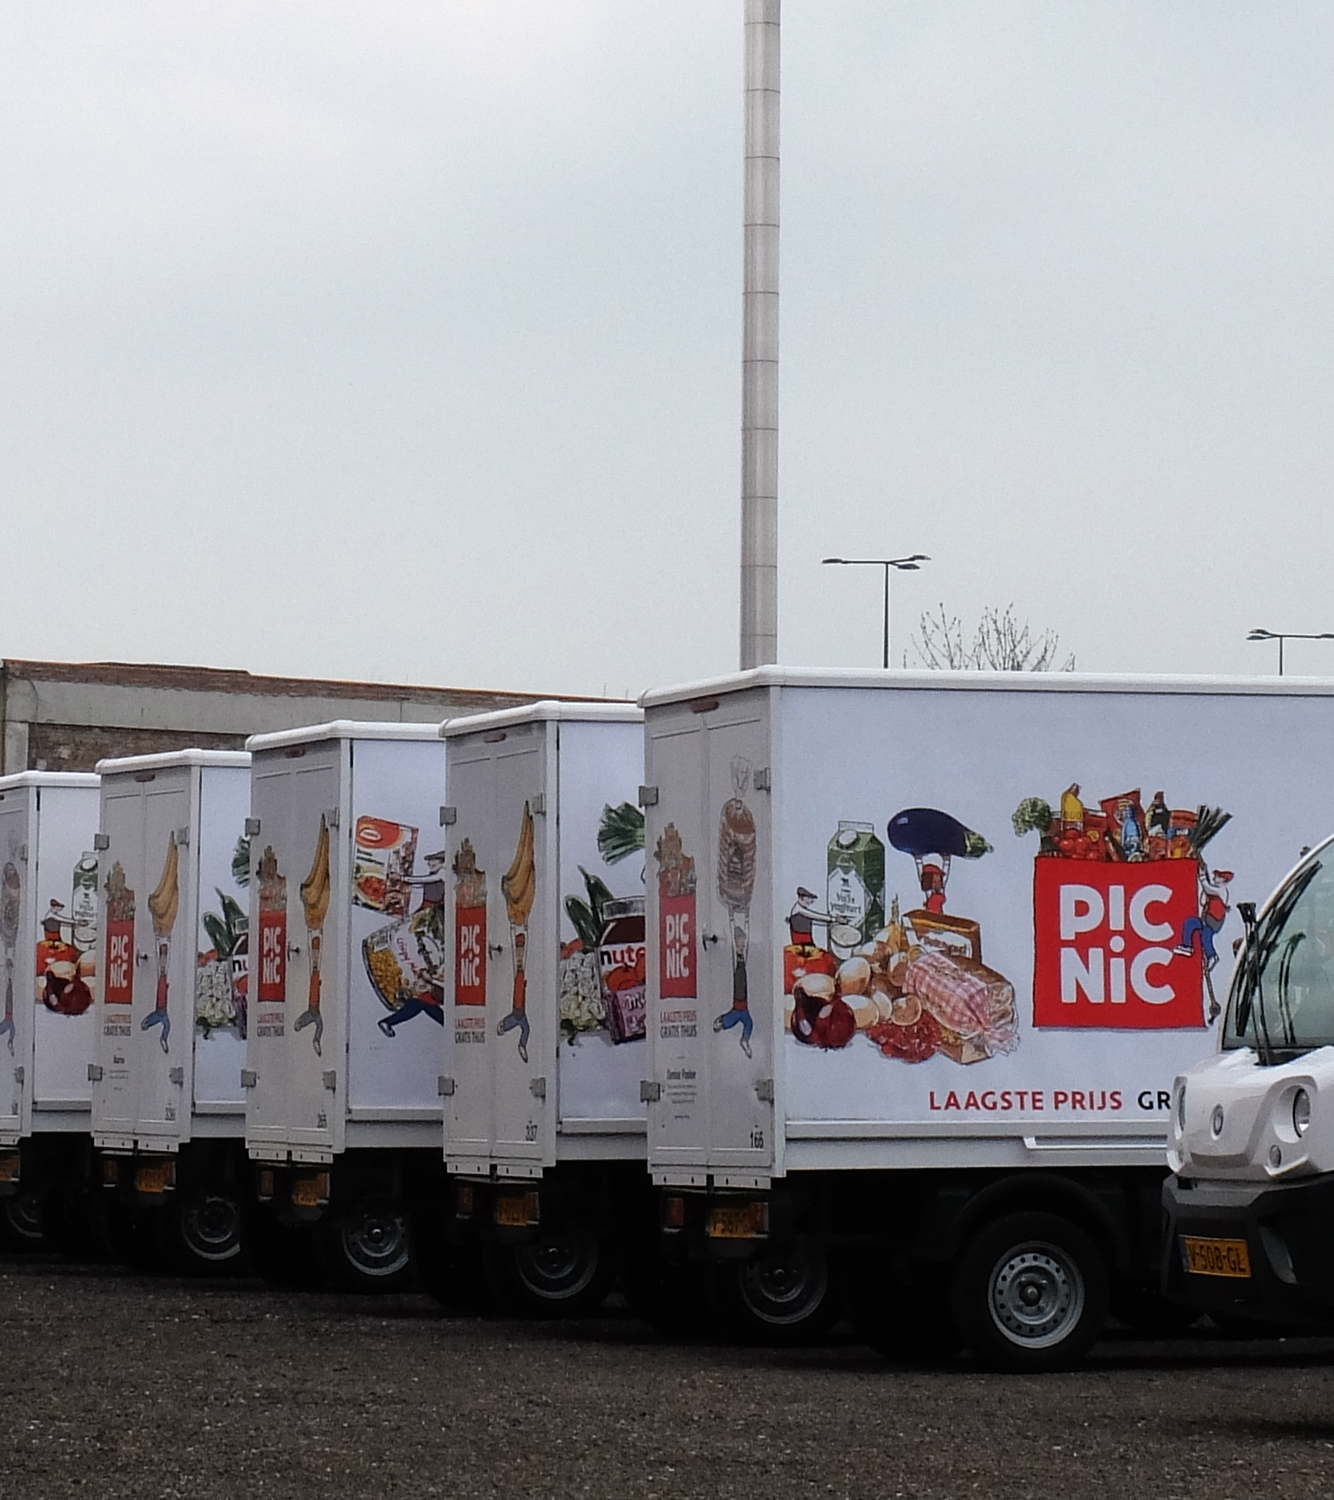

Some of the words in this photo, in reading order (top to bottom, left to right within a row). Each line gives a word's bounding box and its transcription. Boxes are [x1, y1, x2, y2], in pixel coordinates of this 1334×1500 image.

[928, 1090, 1044, 1112] LAAGSTE
[1053, 1090, 1123, 1112] PRIJS
[750, 1131, 764, 1149] 166
